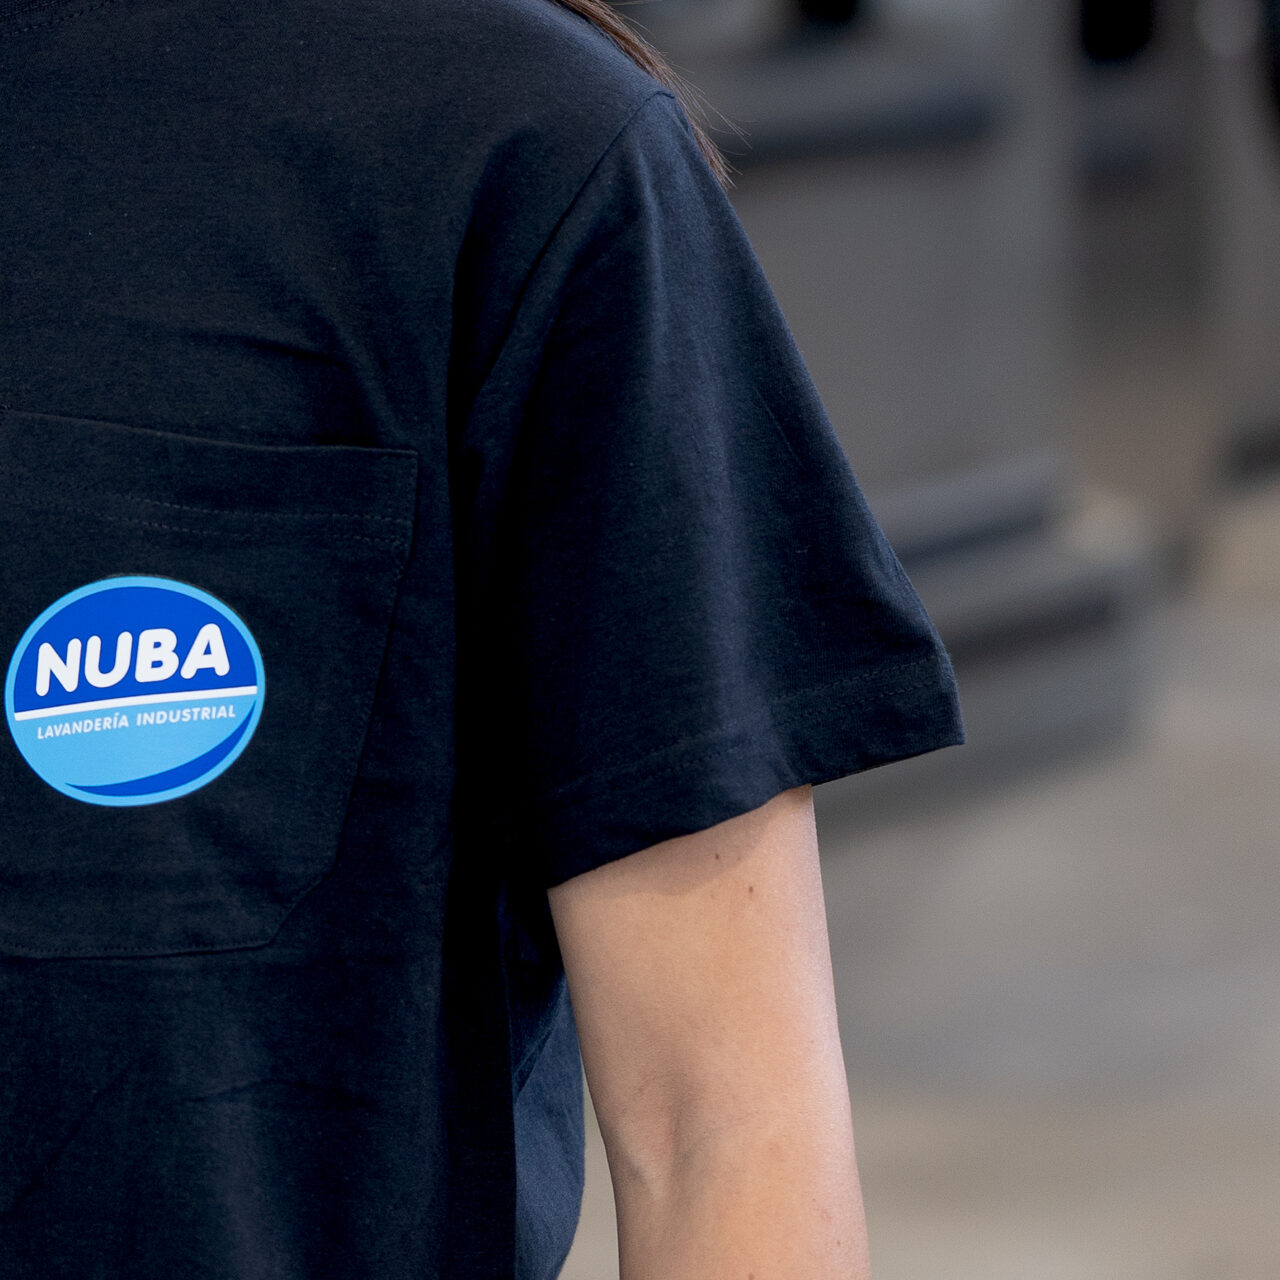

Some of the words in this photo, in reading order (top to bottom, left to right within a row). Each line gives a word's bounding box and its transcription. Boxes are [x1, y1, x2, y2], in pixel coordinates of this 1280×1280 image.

[35, 623, 231, 697] NUBA
[36, 712, 129, 740] LAVANDERÍA
[136, 704, 236, 726] INDUSTRIAL
